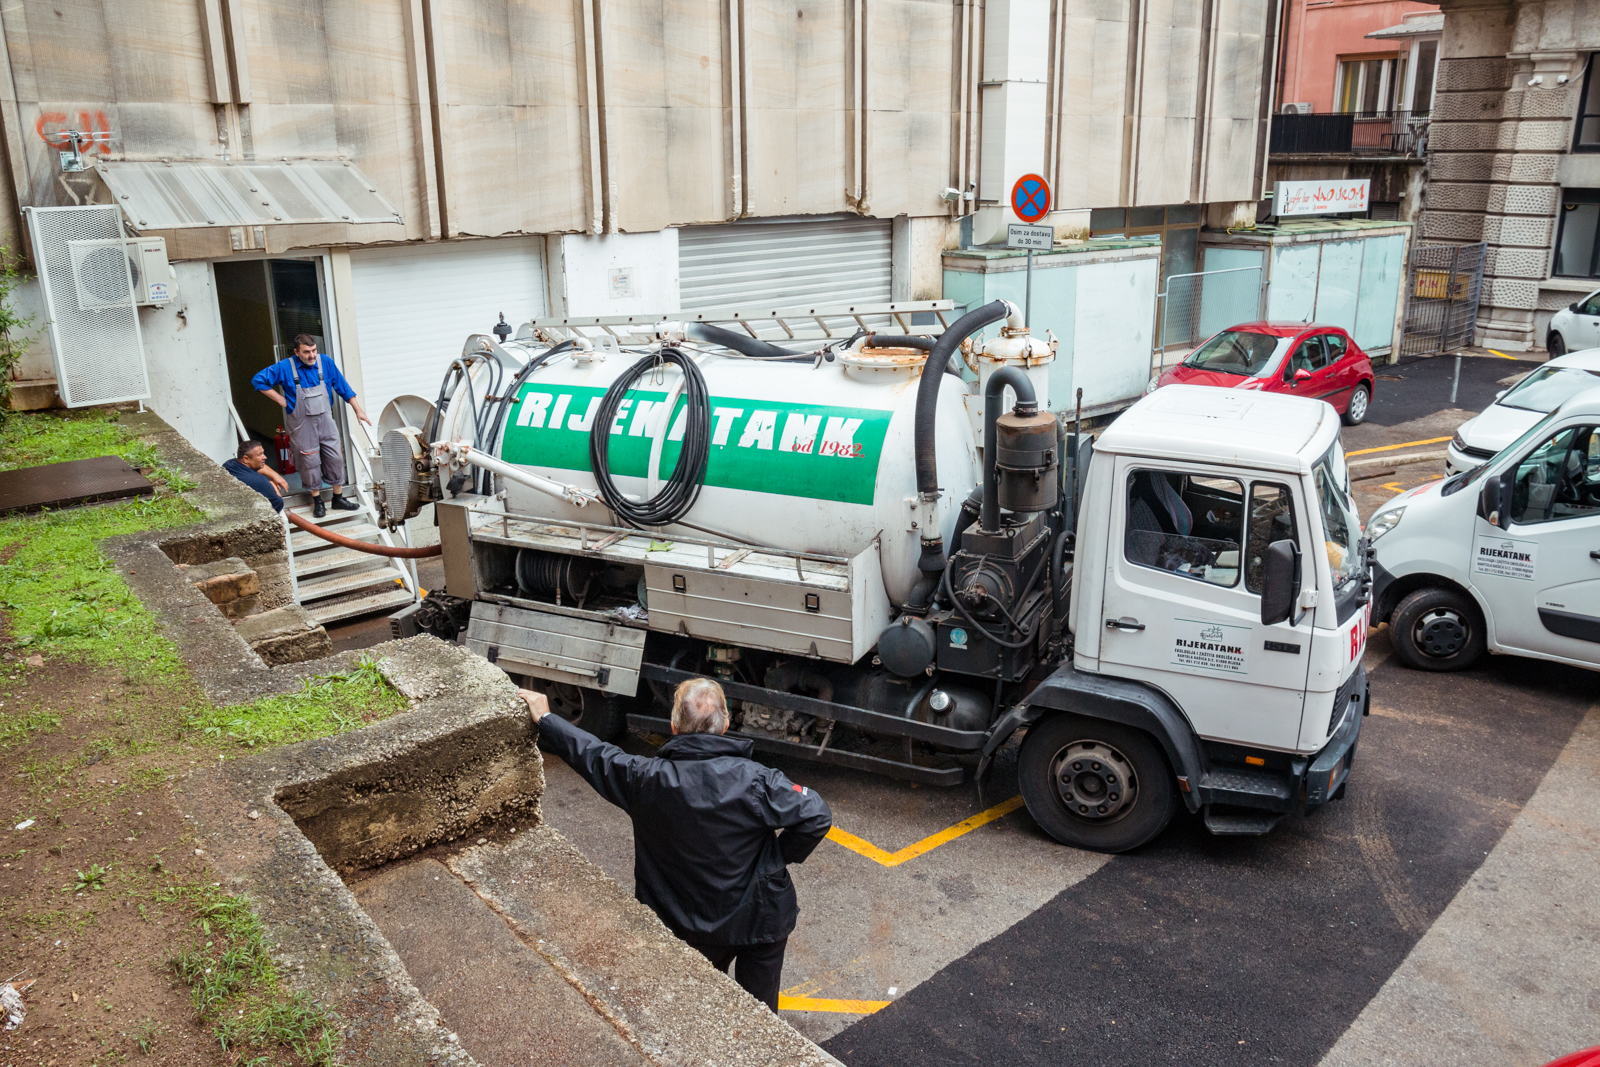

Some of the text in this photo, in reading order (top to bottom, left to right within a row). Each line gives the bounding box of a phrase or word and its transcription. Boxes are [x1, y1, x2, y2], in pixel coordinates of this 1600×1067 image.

[1030, 230, 1050, 238] dostavu
[791, 440, 813, 452] od
[1480, 547, 1531, 561] RIJEKATANK
[1176, 638, 1242, 654] RIJEKATANK
